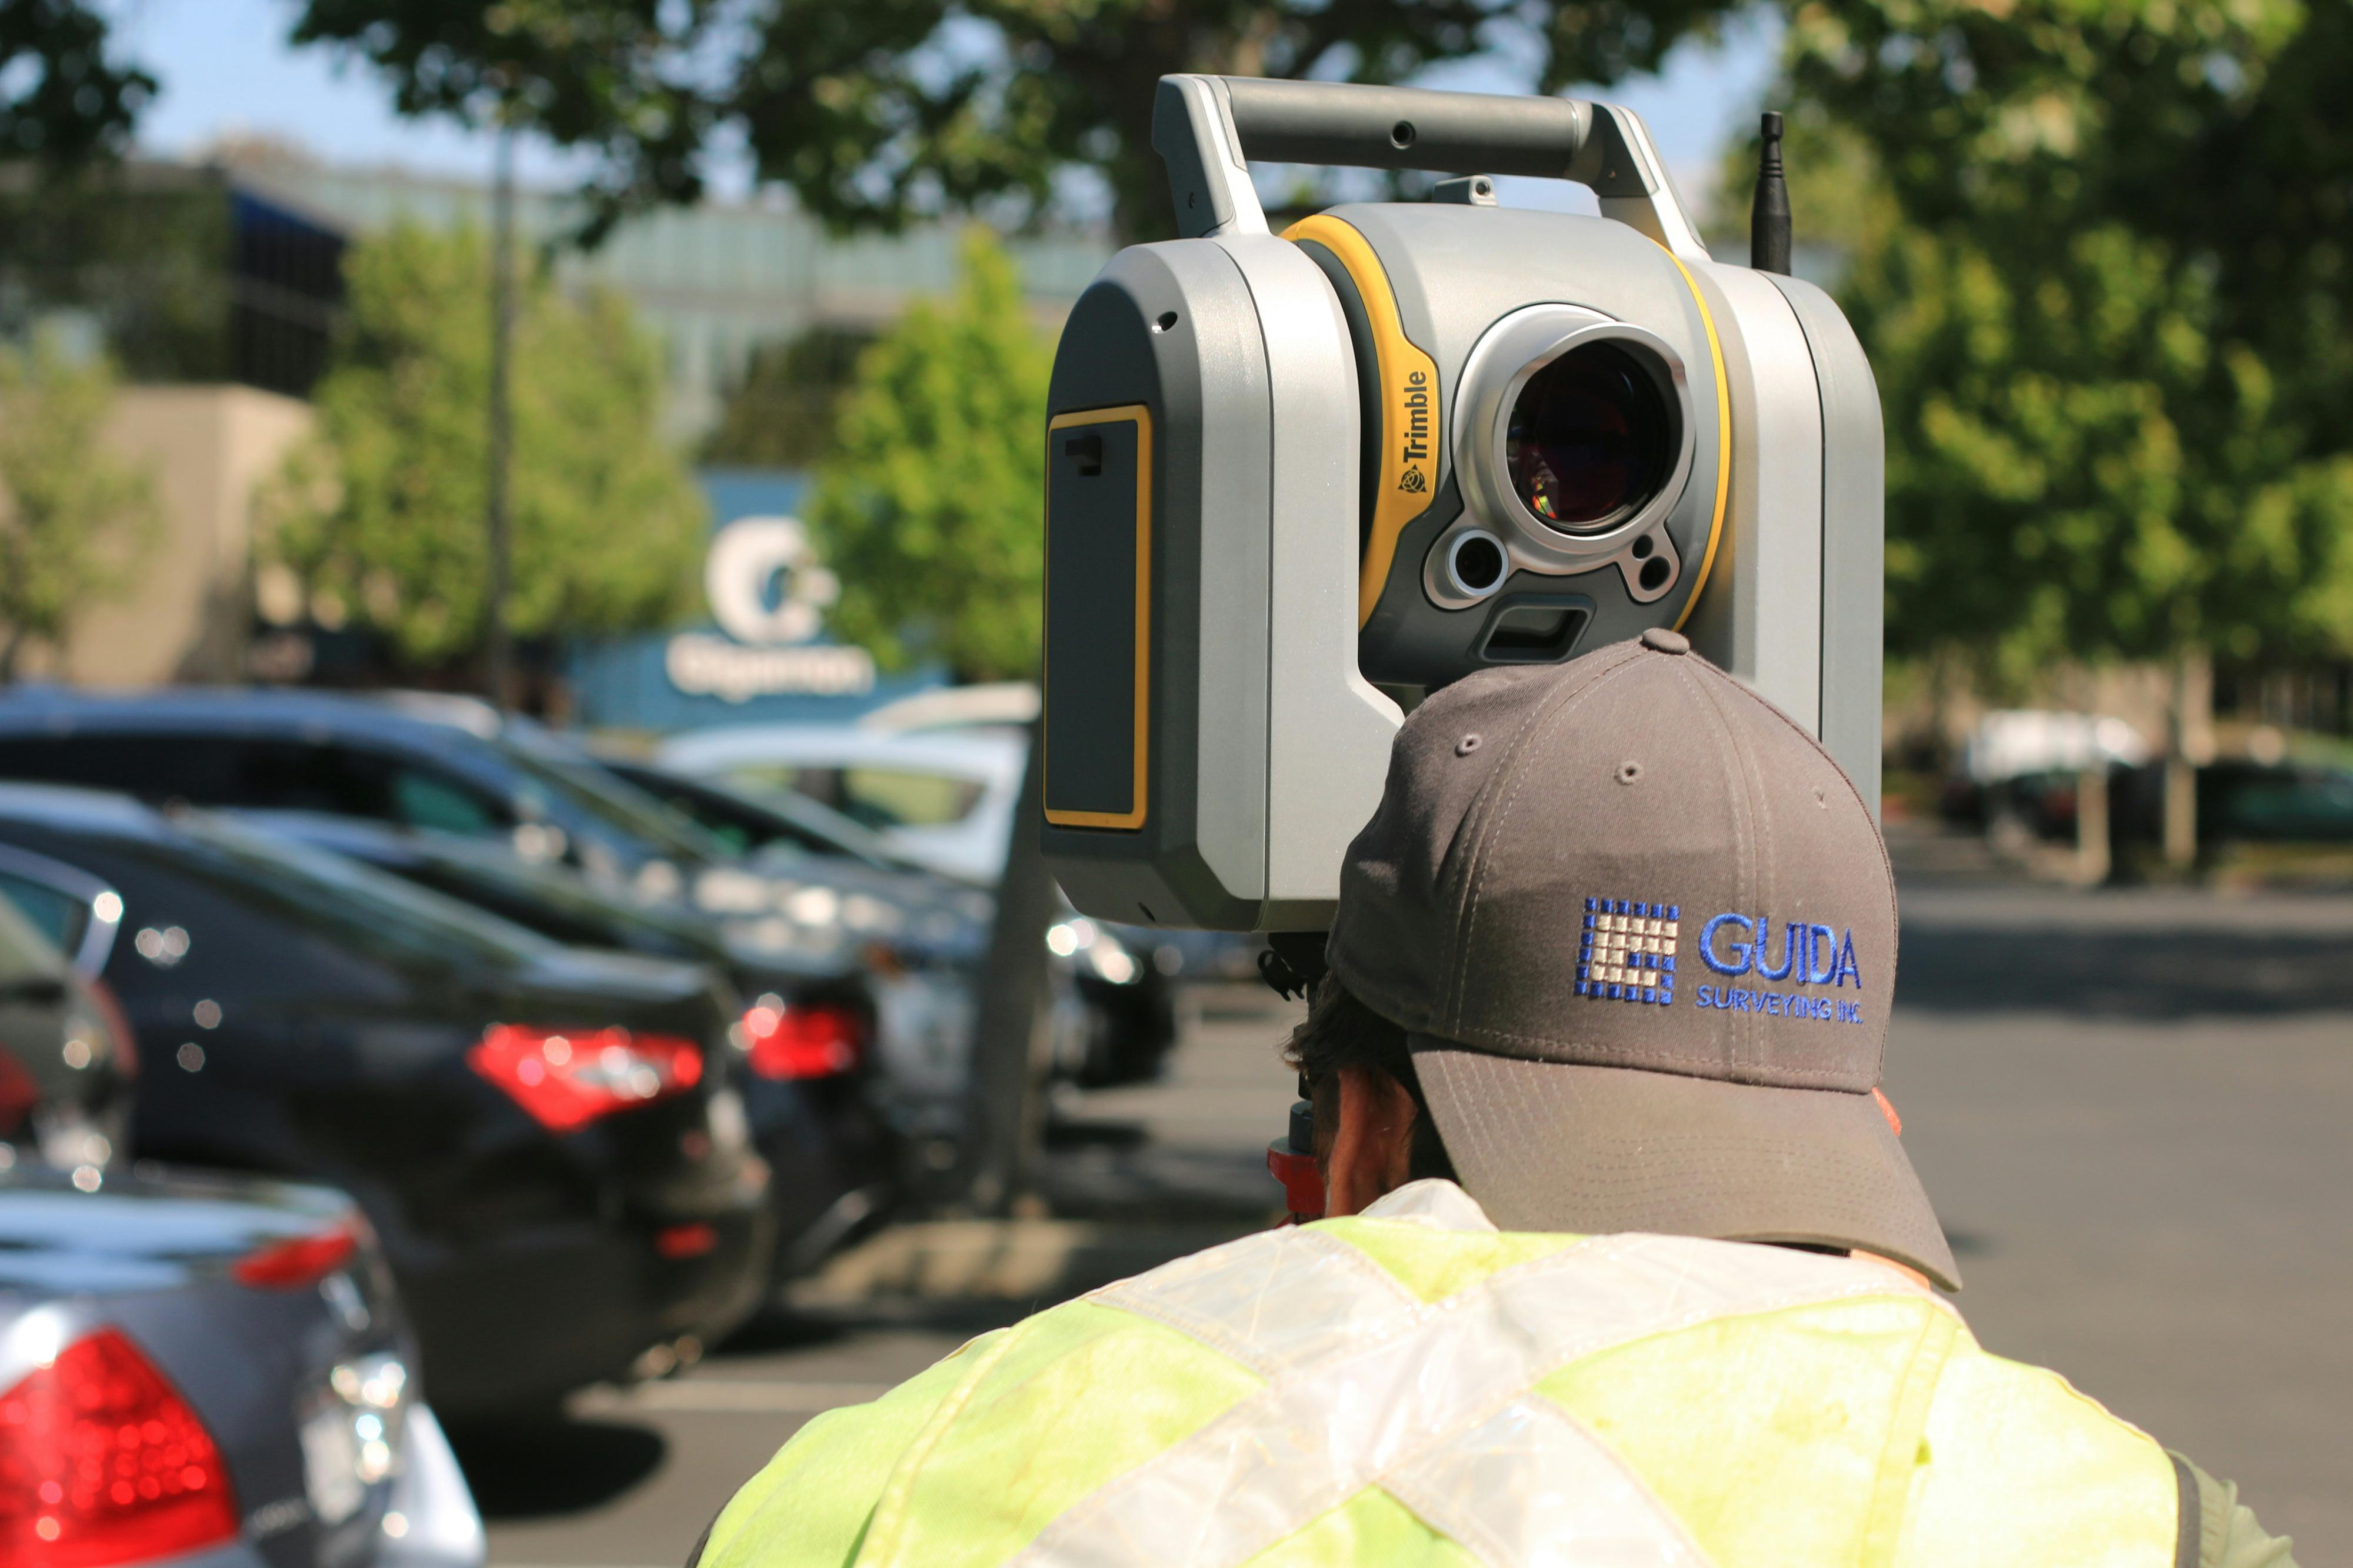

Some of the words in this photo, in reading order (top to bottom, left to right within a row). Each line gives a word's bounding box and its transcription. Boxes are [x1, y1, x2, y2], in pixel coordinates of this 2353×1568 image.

[1403, 371, 1428, 463] Trimble
[1699, 912, 1861, 989] GUIDA
[1695, 985, 1832, 1020] SURVEYING
